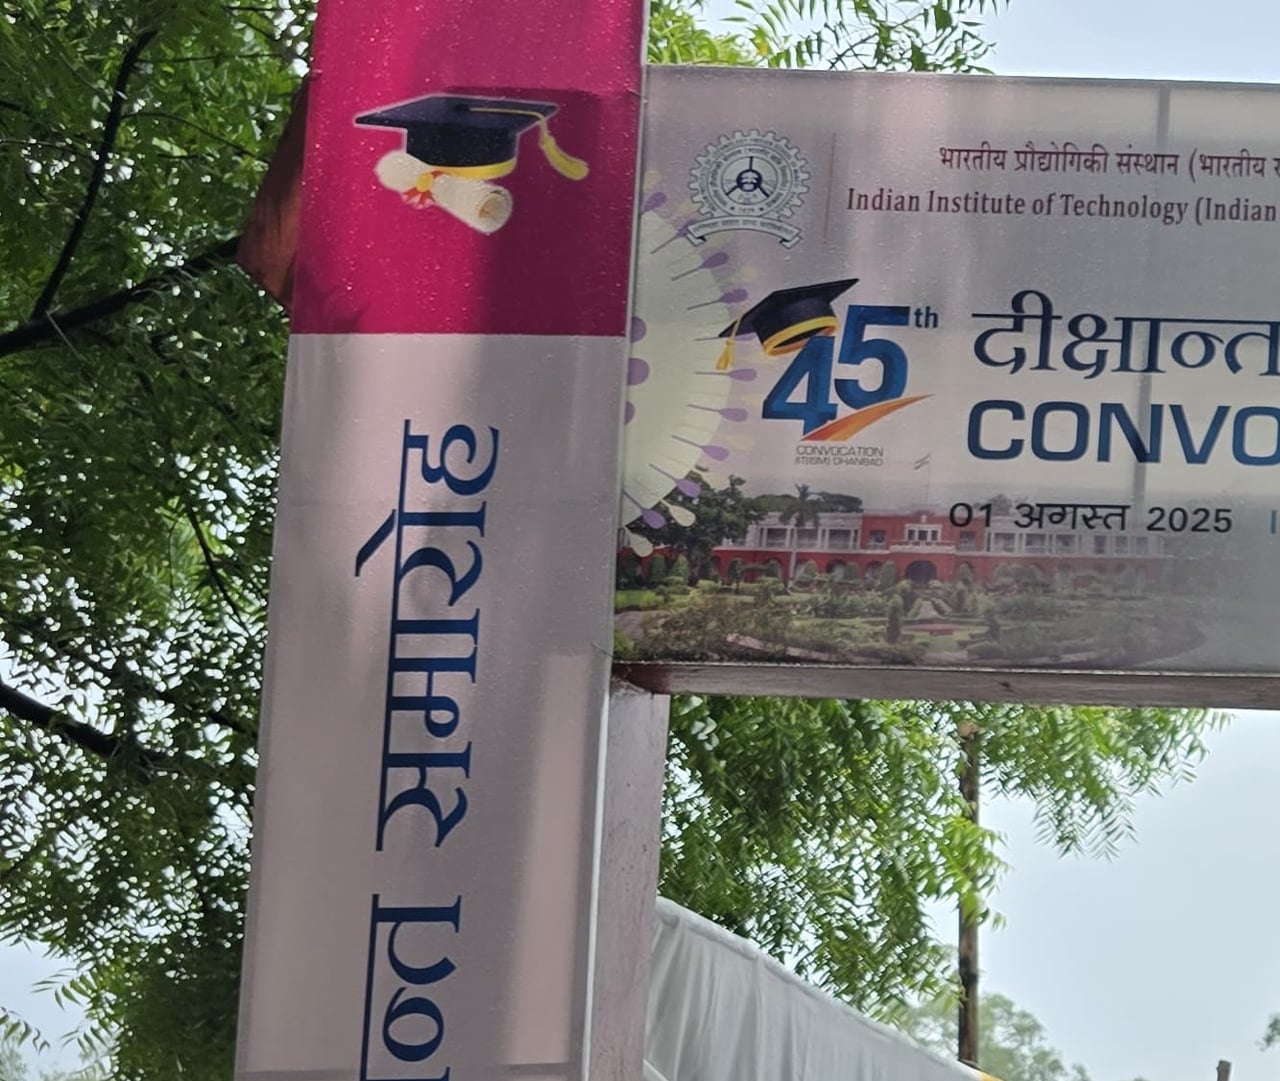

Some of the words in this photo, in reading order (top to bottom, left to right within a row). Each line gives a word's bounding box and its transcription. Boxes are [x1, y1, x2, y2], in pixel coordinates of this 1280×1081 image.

[939, 141, 1008, 170] भारतीय
[1013, 141, 1110, 173] प्रौद्योगिकी
[1115, 145, 1180, 175] संस्थान
[1189, 148, 1267, 183] (भारतीय
[847, 188, 919, 212] Indian
[927, 190, 1025, 214] Institute
[1032, 192, 1056, 215] of
[1060, 193, 1188, 225] Technology
[1195, 197, 1276, 226] (Indian
[796, 445, 884, 457] CONVOCATION
[949, 503, 993, 527] 01
[1014, 503, 1131, 531] अगस्त
[1147, 507, 1232, 533] 2025
[355, 419, 499, 851] समारोह
